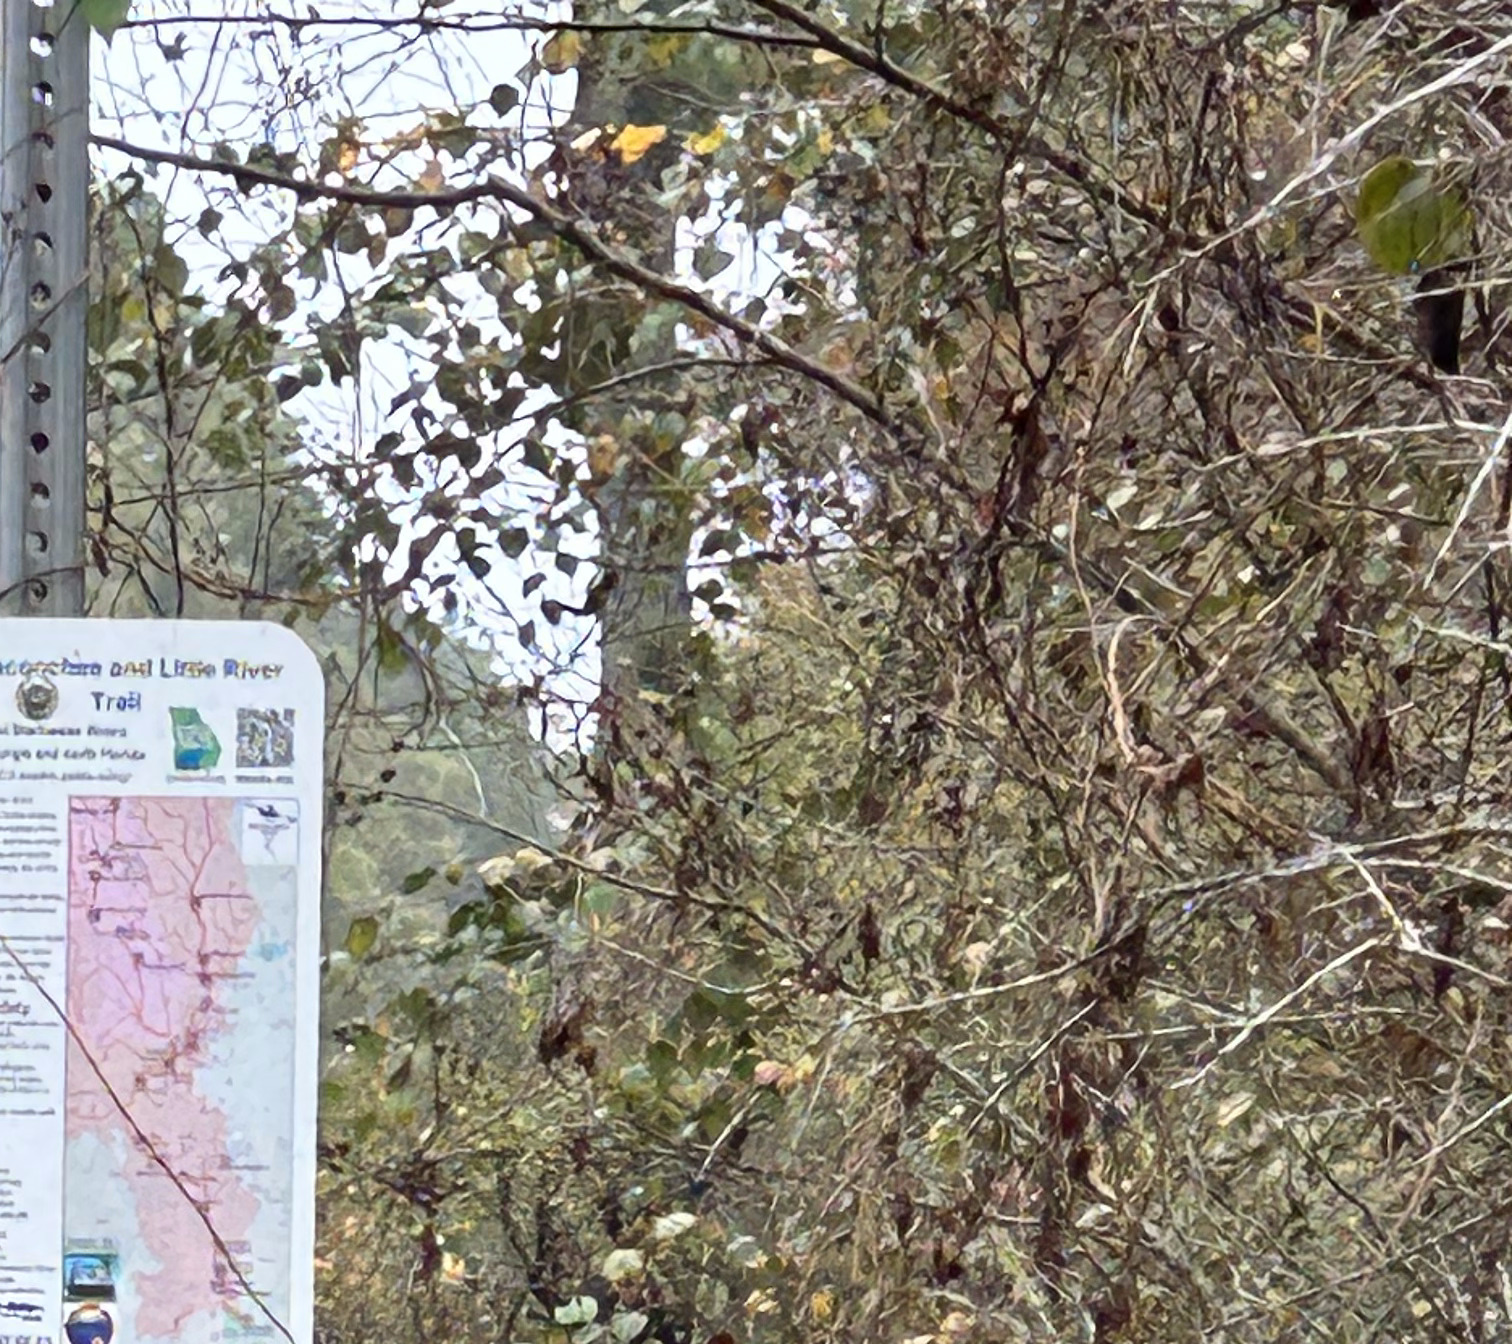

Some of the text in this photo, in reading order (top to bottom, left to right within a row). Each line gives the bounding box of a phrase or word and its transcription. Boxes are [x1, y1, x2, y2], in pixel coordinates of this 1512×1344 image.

[110, 659, 152, 677] and
[161, 657, 216, 678] Ltte
[224, 658, 284, 679] River
[91, 690, 141, 711] Trail
